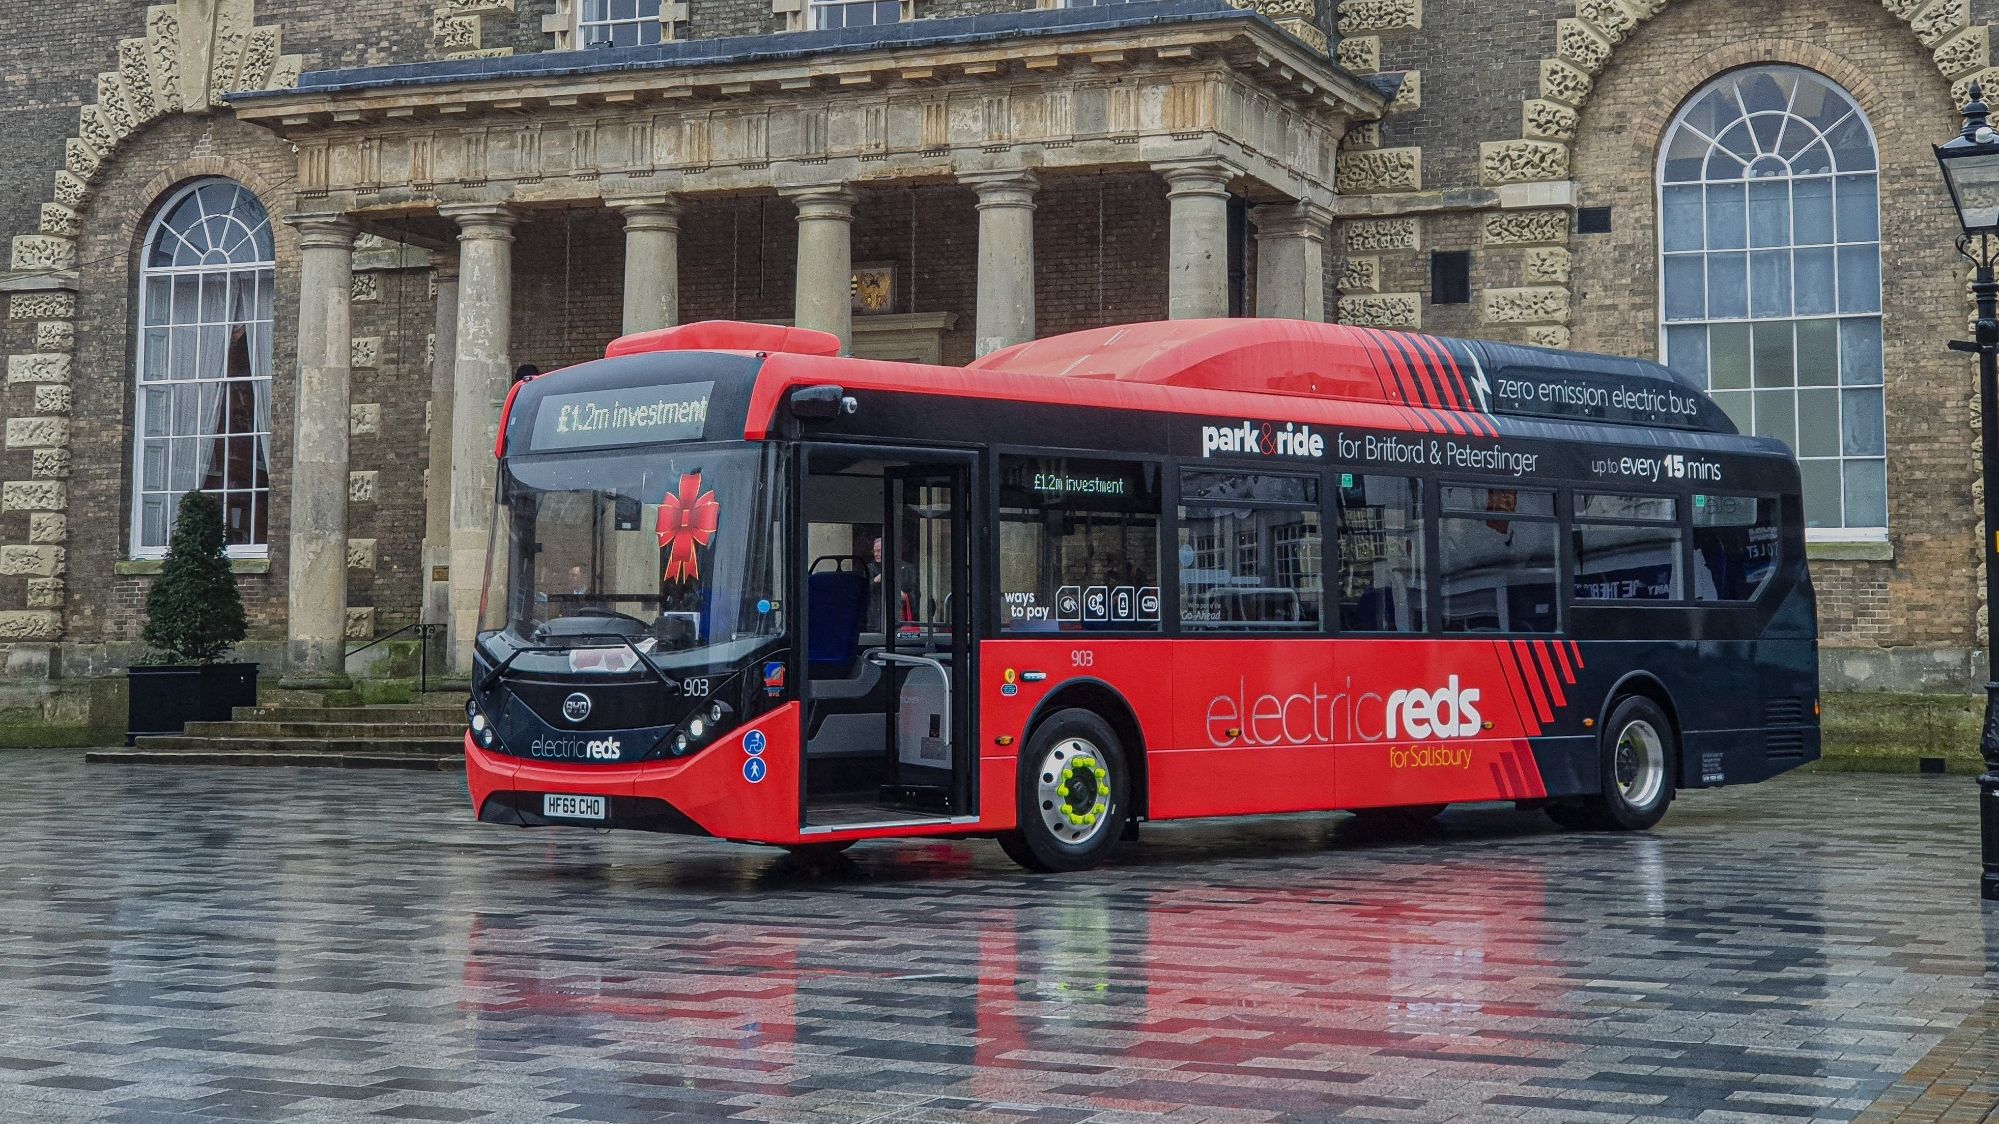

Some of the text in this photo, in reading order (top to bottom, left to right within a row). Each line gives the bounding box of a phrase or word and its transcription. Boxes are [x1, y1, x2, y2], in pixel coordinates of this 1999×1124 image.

[1498, 379, 1697, 415] zero emission electric bus
[557, 396, 709, 432] £1.2m investment
[1337, 433, 1360, 459] for
[1365, 435, 1424, 464] Britford
[1429, 441, 1442, 465] &
[1447, 441, 1539, 476] Petersfinger
[1592, 454, 1722, 482] up to every 15 mins
[1065, 475, 1124, 494] investment
[1004, 592, 1035, 606] ways
[1011, 605, 1049, 621] to pay
[1071, 650, 1093, 667] 903
[684, 678, 709, 697] 903
[1390, 744, 1472, 769] for Salisbury
[549, 796, 599, 815] HF69 CHO
